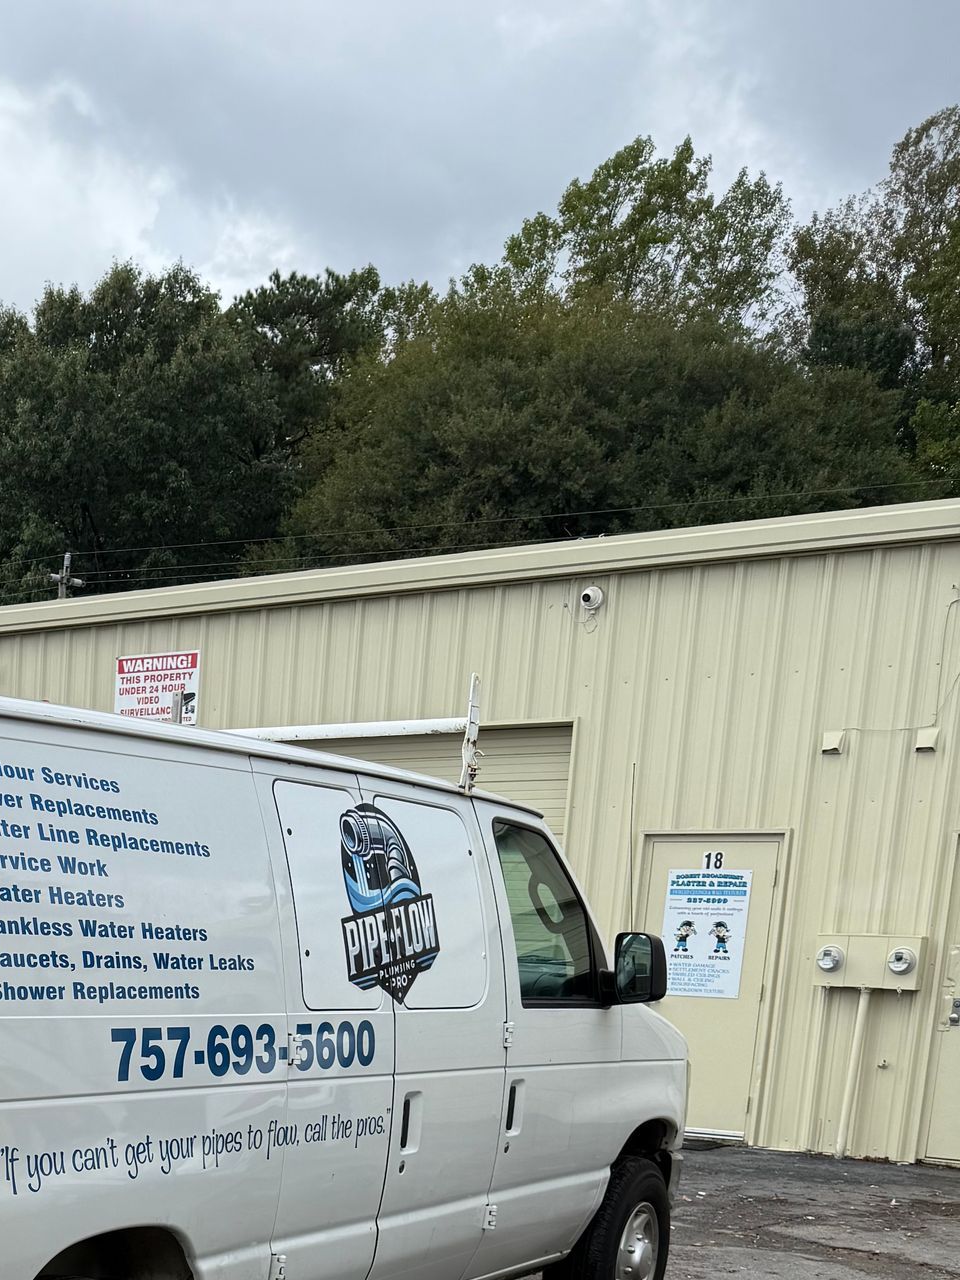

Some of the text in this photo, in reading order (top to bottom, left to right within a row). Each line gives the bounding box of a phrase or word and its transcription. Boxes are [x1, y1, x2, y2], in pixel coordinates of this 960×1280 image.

[122, 655, 192, 672] WARNING!
[119, 686, 147, 695] UNDER
[162, 683, 186, 693] HOUR
[120, 671, 193, 685] THIS PROPERTY
[120, 706, 171, 717] SURVEILLANC
[136, 696, 160, 705] VIDEO
[42, 767, 120, 793] Services
[30, 793, 159, 825] Replacements
[38, 823, 80, 844] Line
[86, 828, 211, 858] Replacements
[58, 856, 108, 877] Work
[705, 852, 724, 870] 18
[48, 886, 125, 908] Heaters
[79, 920, 135, 939] Water
[142, 922, 208, 942] Heaters
[82, 950, 148, 972] Drains,
[153, 953, 203, 970] Water
[210, 954, 255, 972] Leaks
[379, 959, 416, 980] PLUMBING
[73, 982, 200, 1004] Replacements
[111, 1020, 375, 1082] 757-693-5600
[26, 1151, 66, 1192] you
[72, 1138, 119, 1172] can't
[125, 1135, 154, 1180] get
[159, 1135, 197, 1174] your
[202, 1129, 242, 1169] pipes
[248, 1124, 263, 1150] to
[267, 1120, 300, 1160] flow,
[304, 1115, 328, 1142] call
[332, 1114, 353, 1140] the
[354, 1108, 391, 1148] pros."
